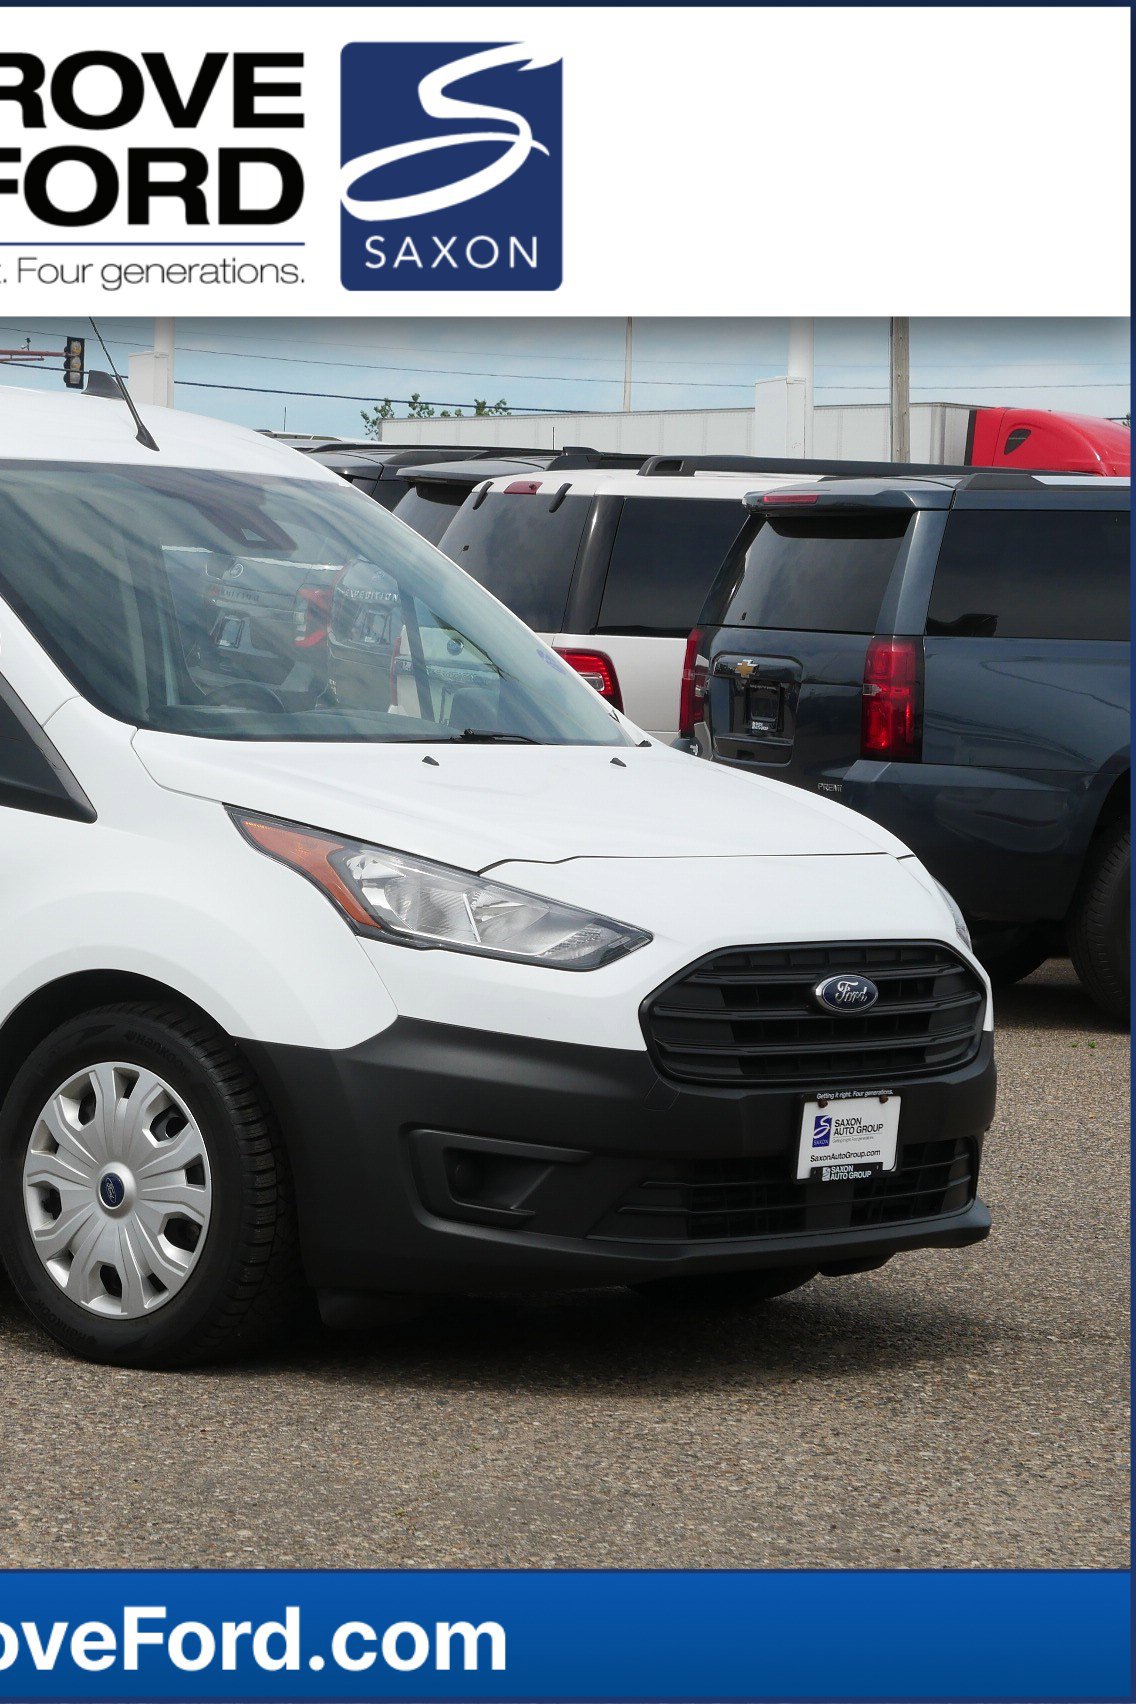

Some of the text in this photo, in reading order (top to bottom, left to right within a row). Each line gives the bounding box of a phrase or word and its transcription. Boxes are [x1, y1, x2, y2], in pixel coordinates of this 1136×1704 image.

[835, 981, 868, 1003] Ford
[817, 1092, 834, 1100] Getting
[834, 1117, 862, 1127] SAXON
[834, 1124, 884, 1136] AUTO GROUP
[810, 1150, 881, 1162] SaxonAutoGroup.com
[831, 1165, 854, 1173] SAXON
[831, 1171, 872, 1180] AUTO GROUP
